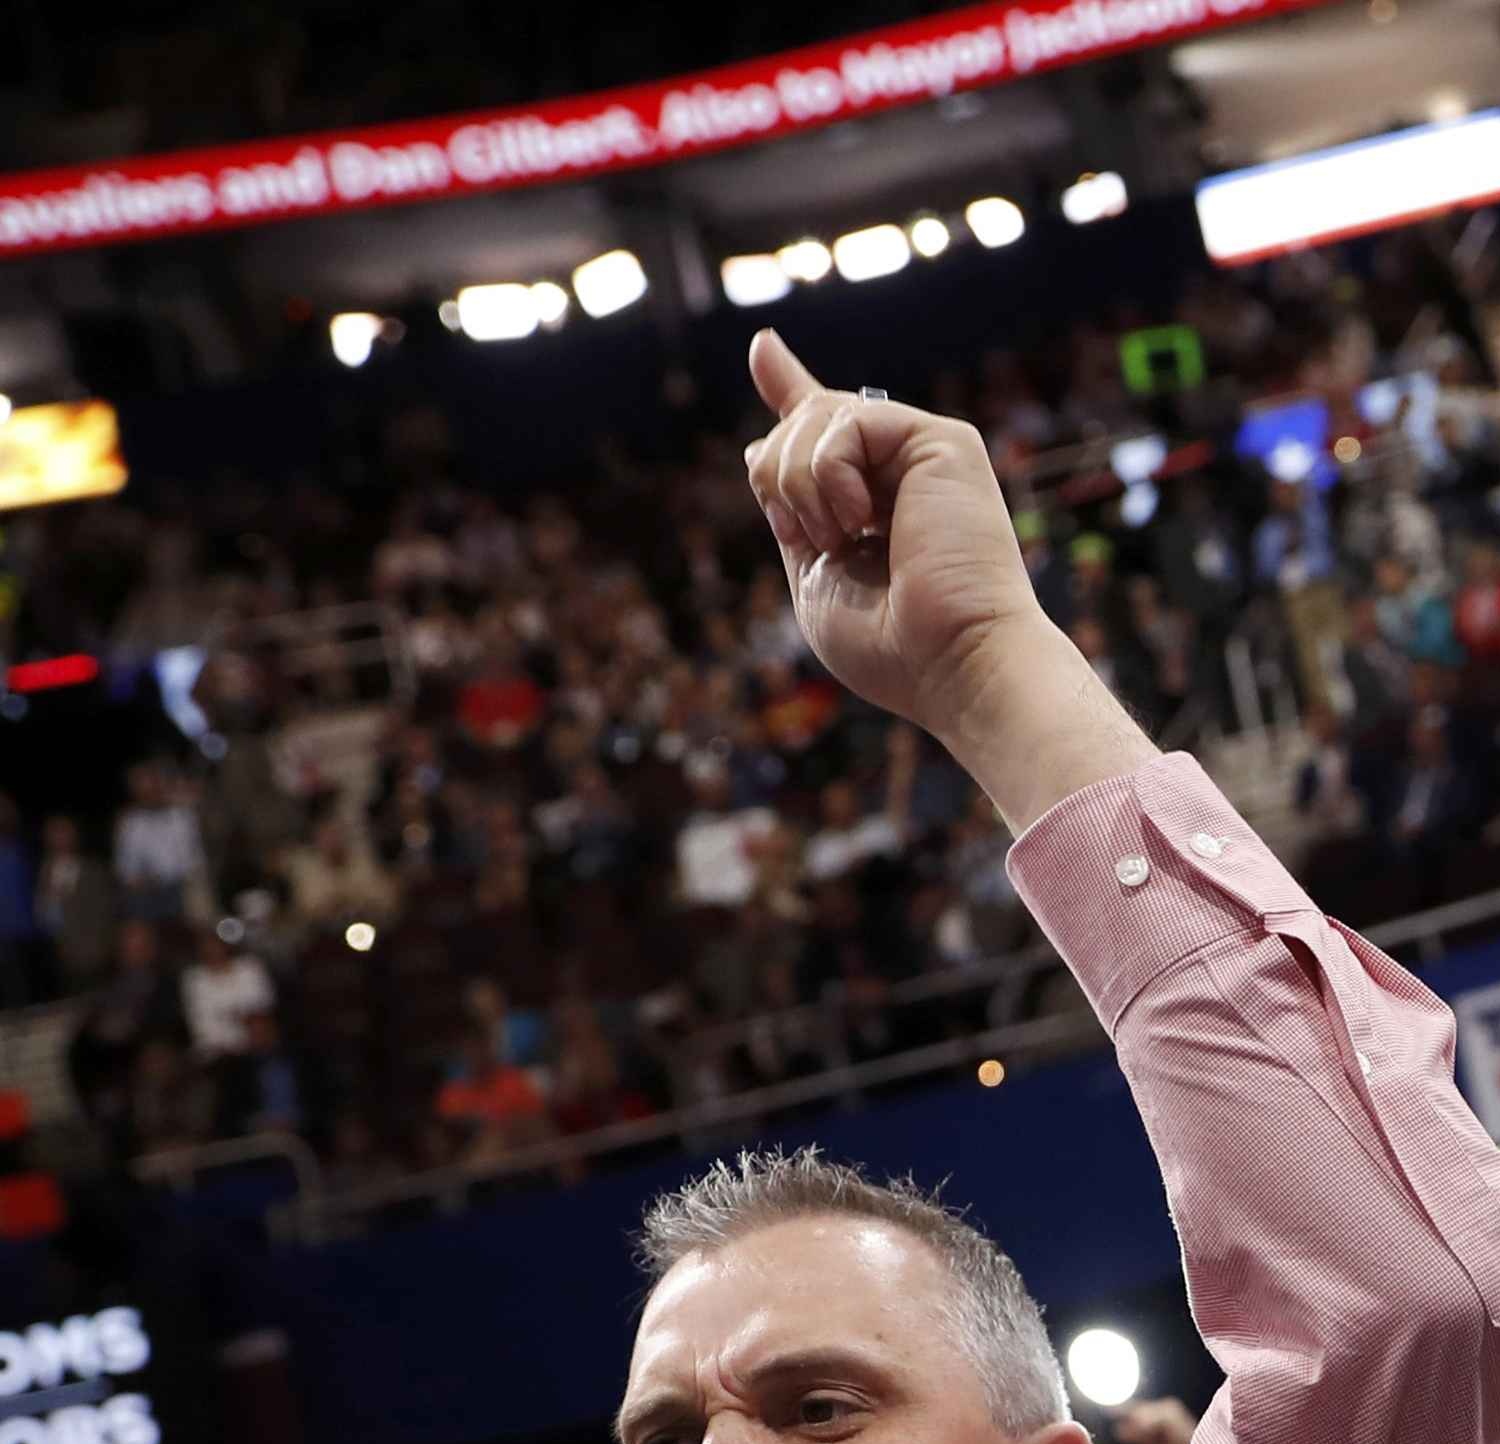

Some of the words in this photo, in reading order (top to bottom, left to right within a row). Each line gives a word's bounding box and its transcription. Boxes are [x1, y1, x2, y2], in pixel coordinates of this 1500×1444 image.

[217, 147, 328, 213] and
[330, 141, 450, 200] Dan
[658, 85, 778, 149] Also
[774, 68, 845, 120] to
[840, 27, 1003, 104] Mayor
